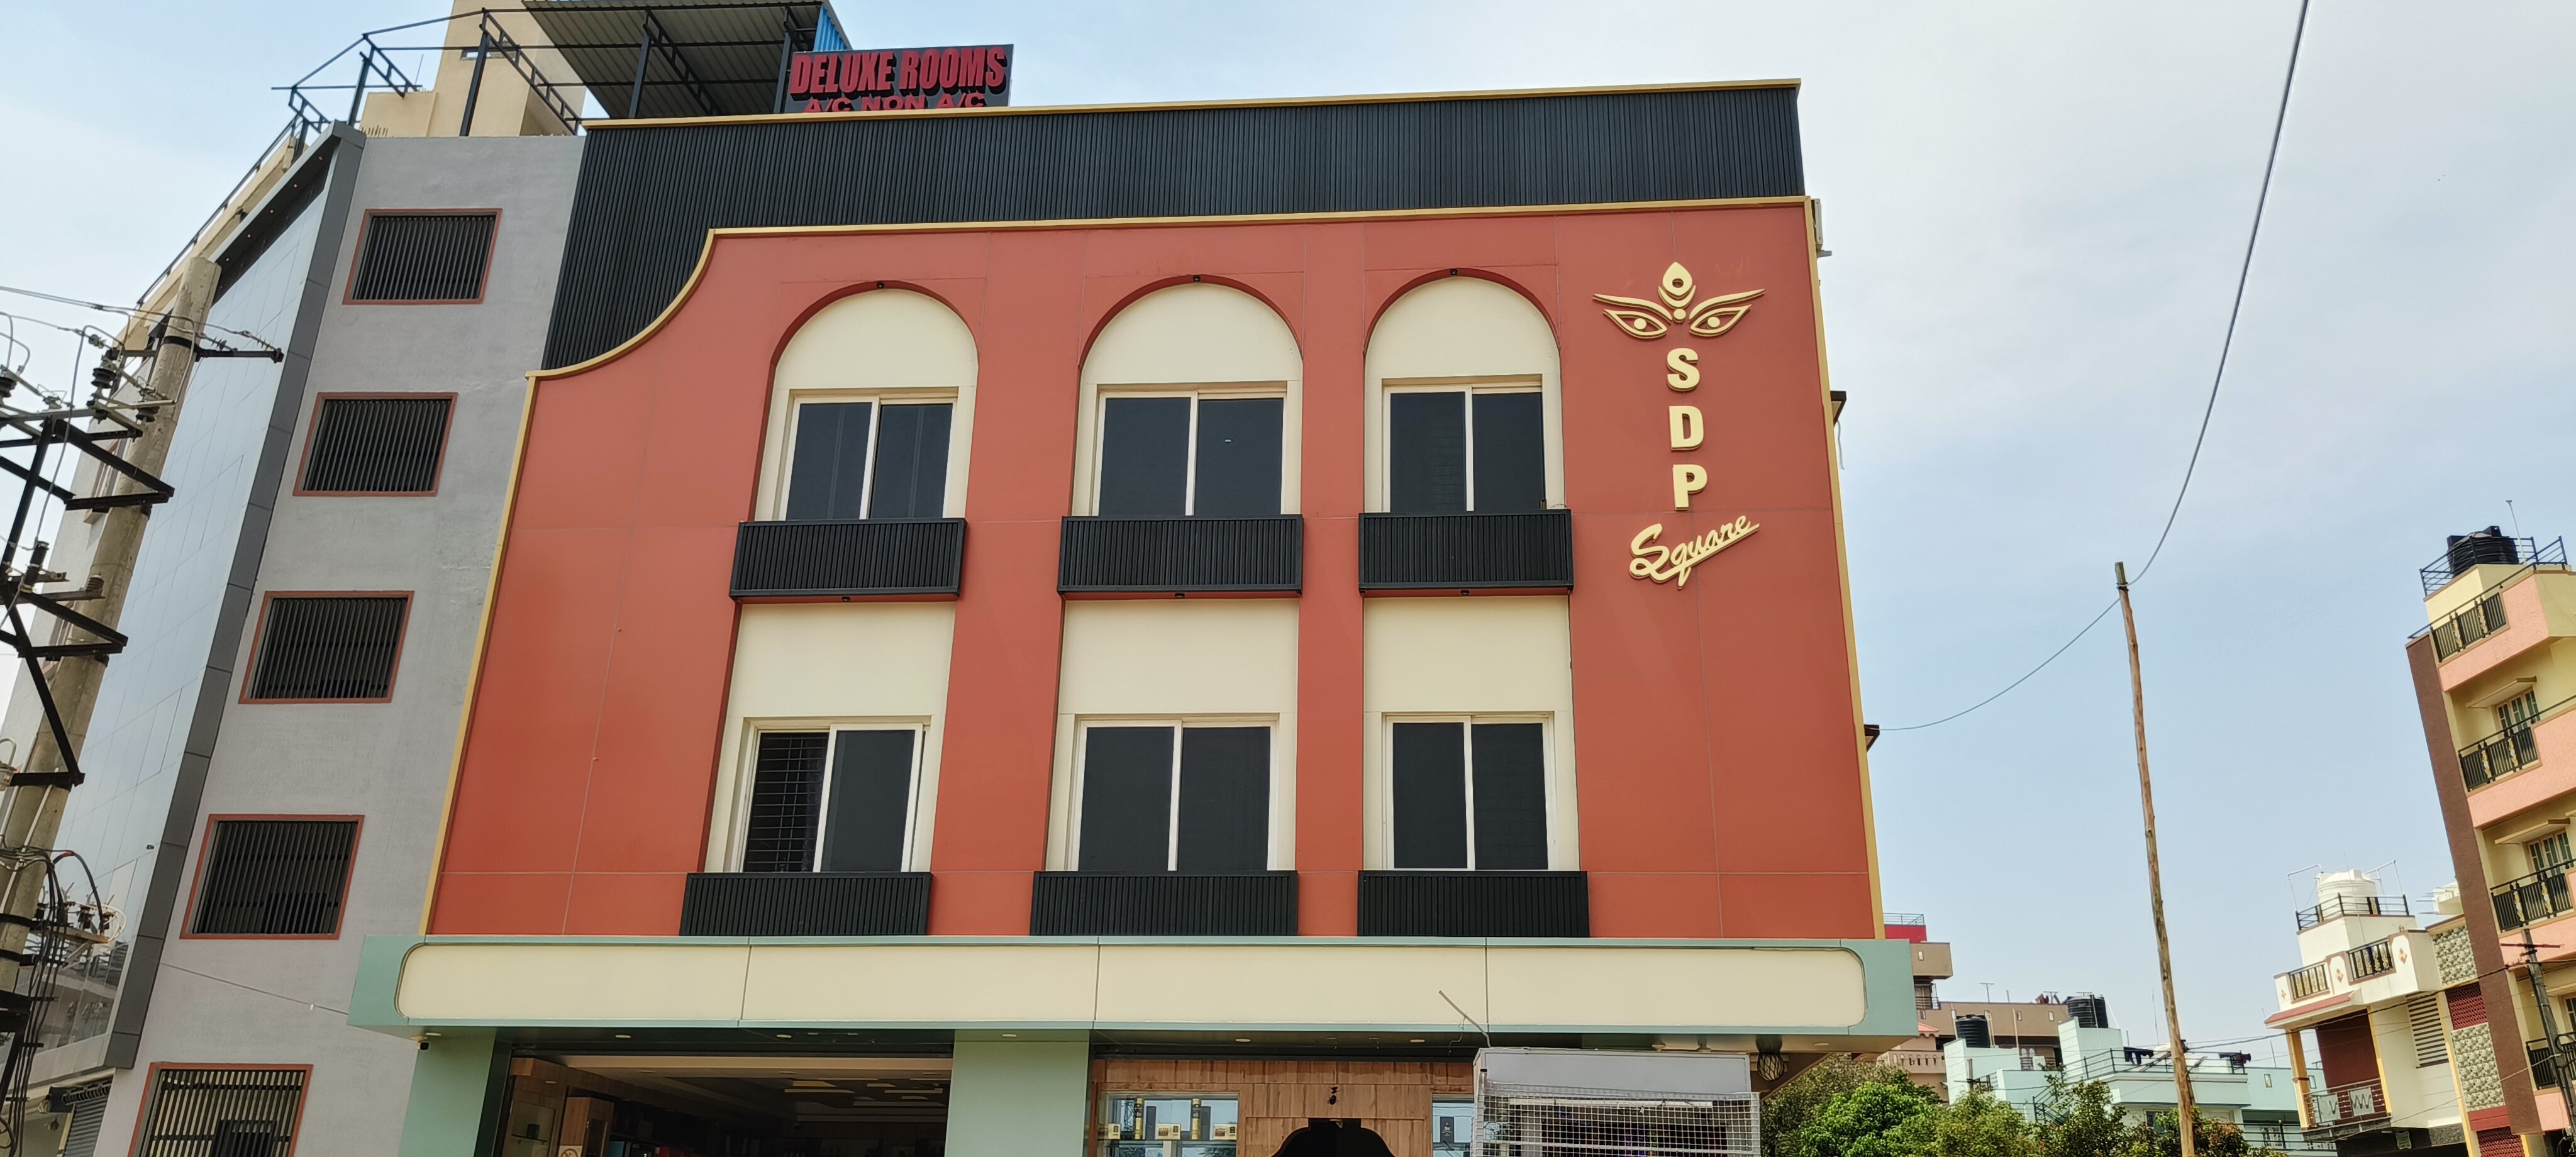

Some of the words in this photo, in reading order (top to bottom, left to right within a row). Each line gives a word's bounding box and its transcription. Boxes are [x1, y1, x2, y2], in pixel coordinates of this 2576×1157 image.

[789, 51, 894, 94] DELUXE
[899, 47, 1005, 89] ROOMS
[802, 97, 852, 113] A/C
[861, 94, 926, 111] NON
[936, 92, 985, 108] A/C
[1629, 514, 1760, 590] Square
